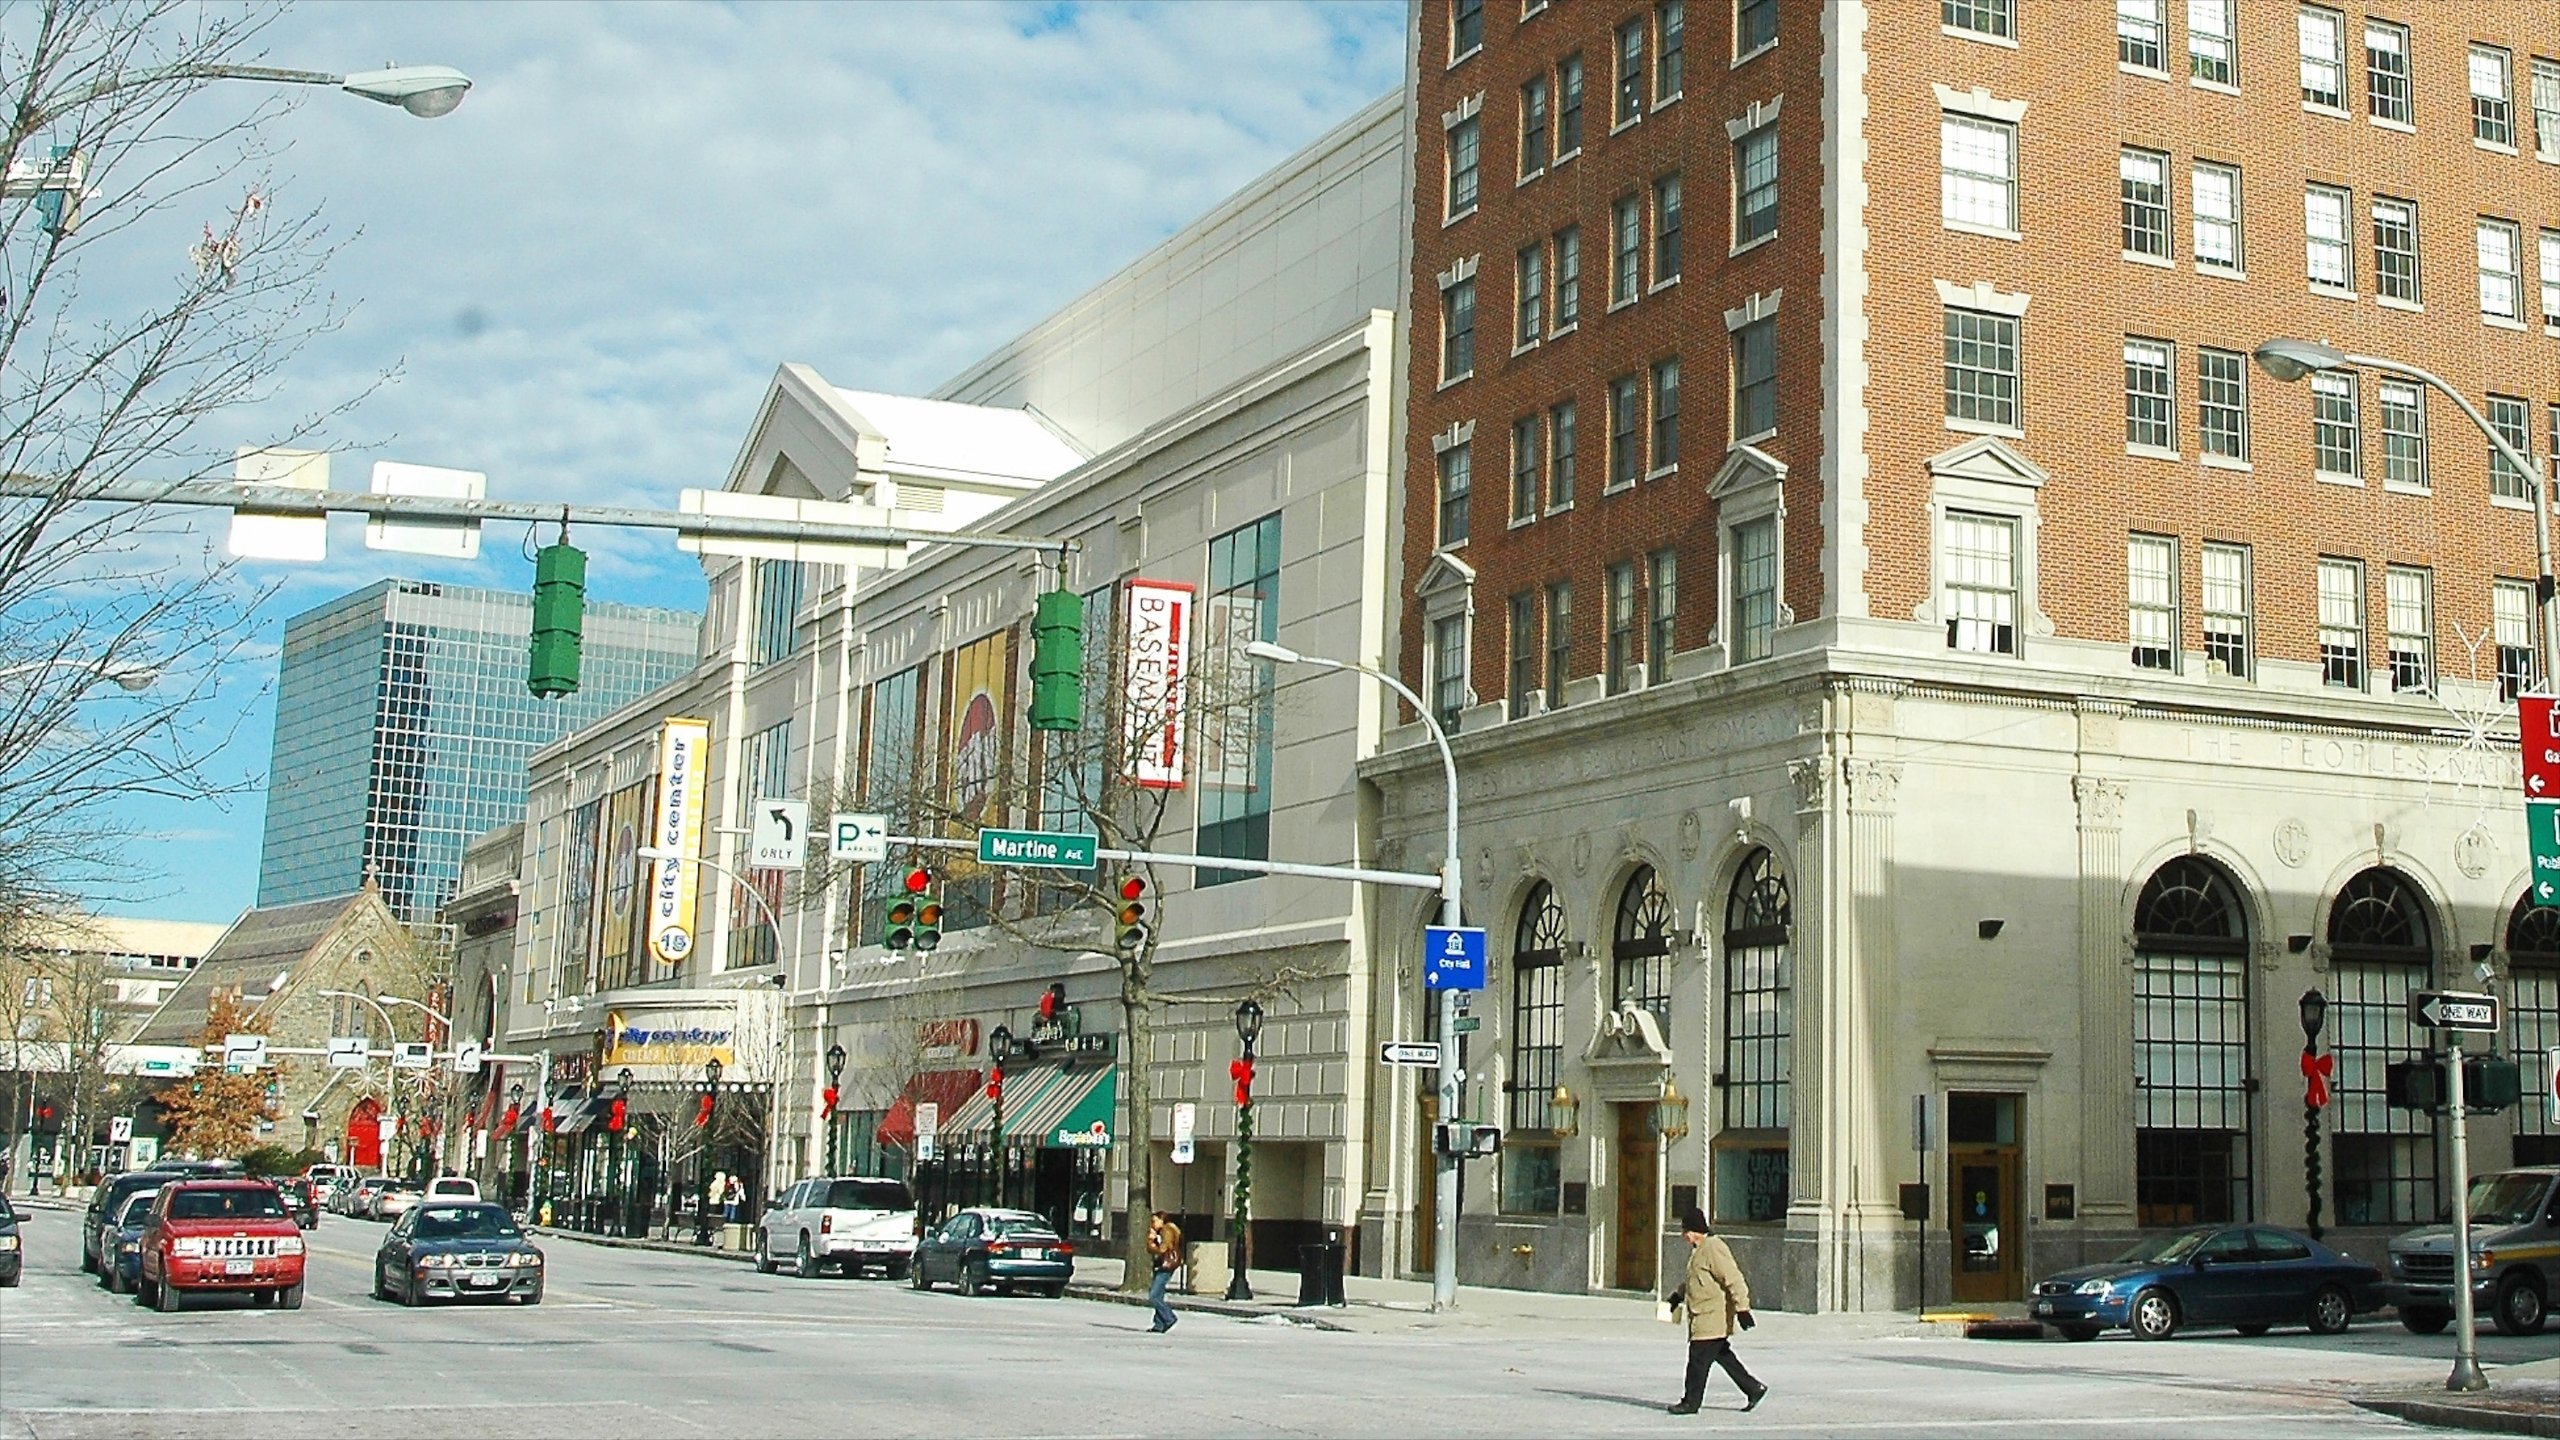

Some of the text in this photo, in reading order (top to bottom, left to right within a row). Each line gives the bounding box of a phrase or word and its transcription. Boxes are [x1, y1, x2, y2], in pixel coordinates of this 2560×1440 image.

[2180, 728, 2243, 760] THE
[2280, 737, 2431, 776] PEOPLES
[2545, 749, 2560, 764] Ga
[659, 738, 685, 917] city center
[760, 848, 792, 859] ONLY
[992, 837, 1057, 859] Martine
[661, 934, 686, 952] 15
[1439, 958, 1471, 970] City Hall
[2440, 1005, 2489, 1019] ONE WAY
